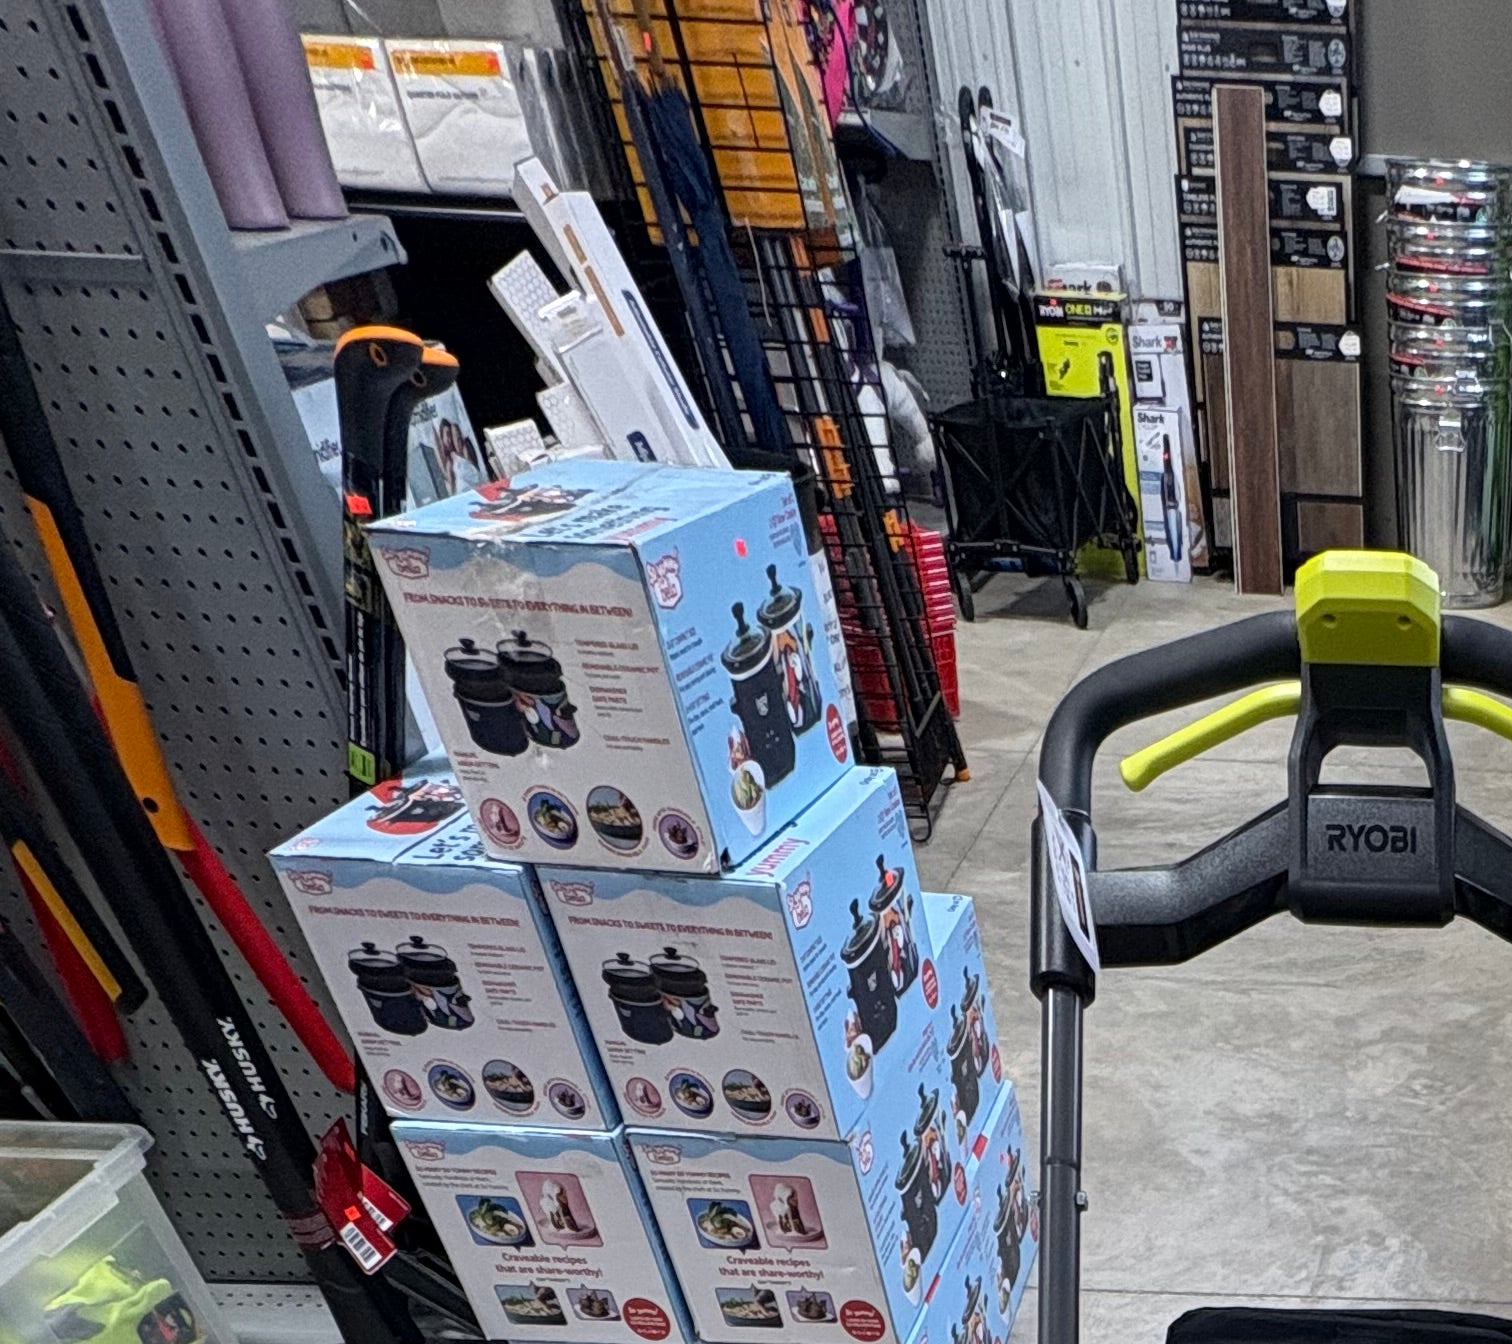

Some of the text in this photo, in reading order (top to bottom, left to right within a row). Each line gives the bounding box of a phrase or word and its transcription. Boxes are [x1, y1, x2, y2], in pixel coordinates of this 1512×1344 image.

[1131, 336, 1162, 349] Shark
[1137, 412, 1165, 423] Shark
[1325, 824, 1417, 855] RYOBI
[746, 837, 810, 877] yummy
[216, 1016, 267, 1092] HUSKY
[202, 1058, 256, 1134] HUSKY
[502, 1252, 587, 1266] Craveable recipes
[726, 1255, 811, 1267] Craveable recipes
[496, 1264, 516, 1273] that
[719, 1267, 739, 1277] that
[742, 1269, 757, 1277] are
